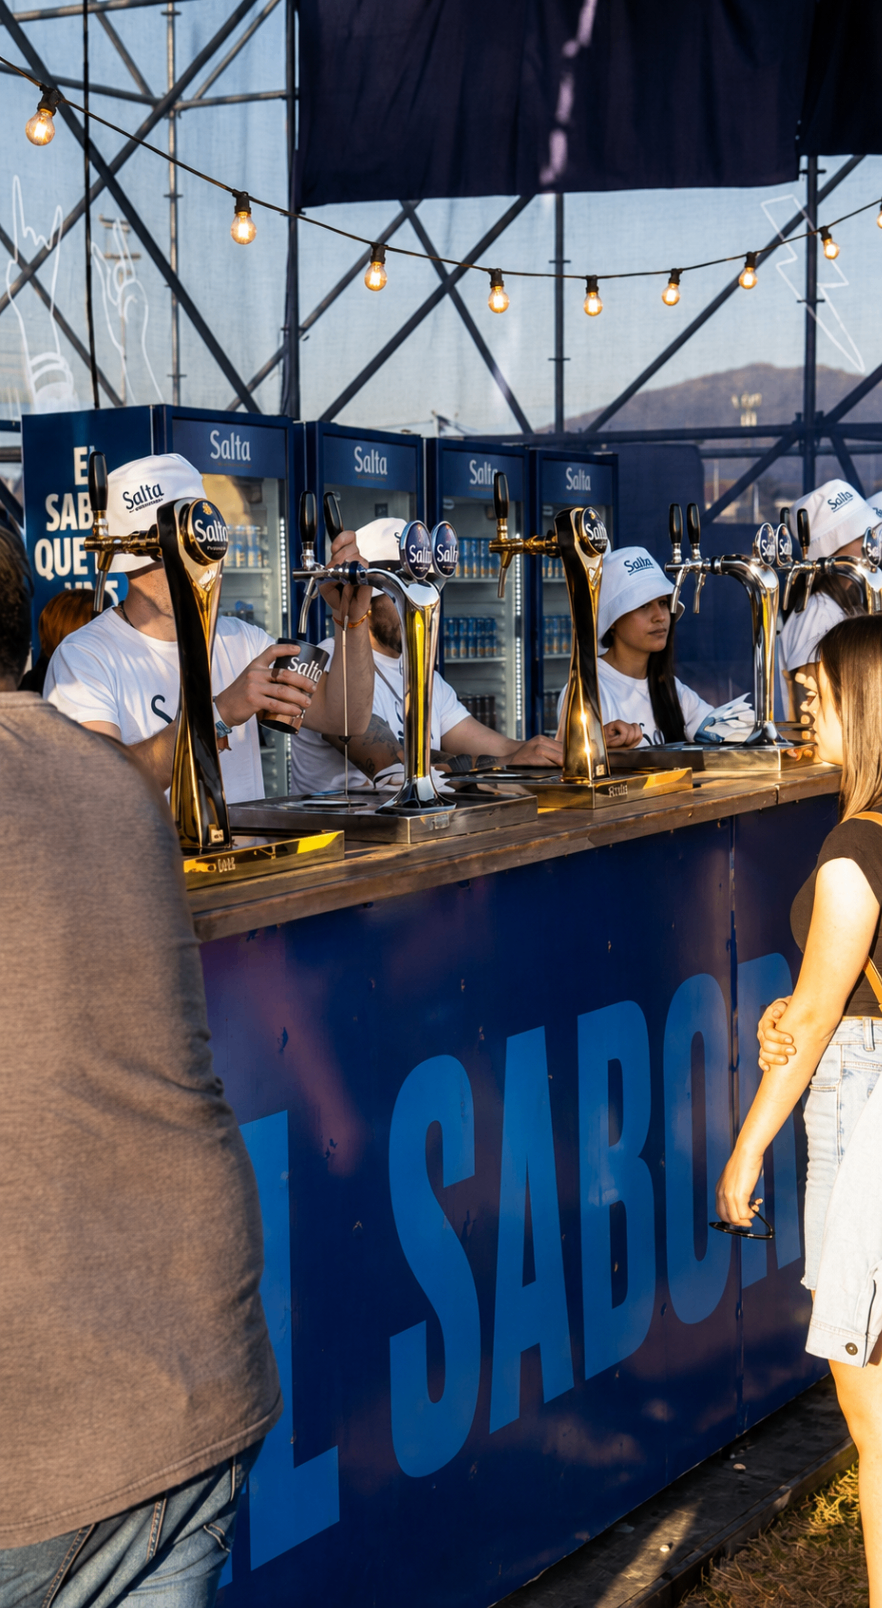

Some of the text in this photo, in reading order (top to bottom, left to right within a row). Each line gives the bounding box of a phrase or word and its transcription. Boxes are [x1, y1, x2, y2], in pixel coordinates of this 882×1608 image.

[209, 429, 252, 462] Salta
[353, 445, 388, 476] Salta
[73, 445, 96, 486] E
[565, 466, 592, 492] Salta
[44, 491, 94, 532] SAB
[122, 483, 165, 510] Salta
[194, 518, 229, 543] Salta
[33, 536, 89, 581] QUE
[287, 656, 323, 683] Salta
[215, 1108, 341, 1590] L
